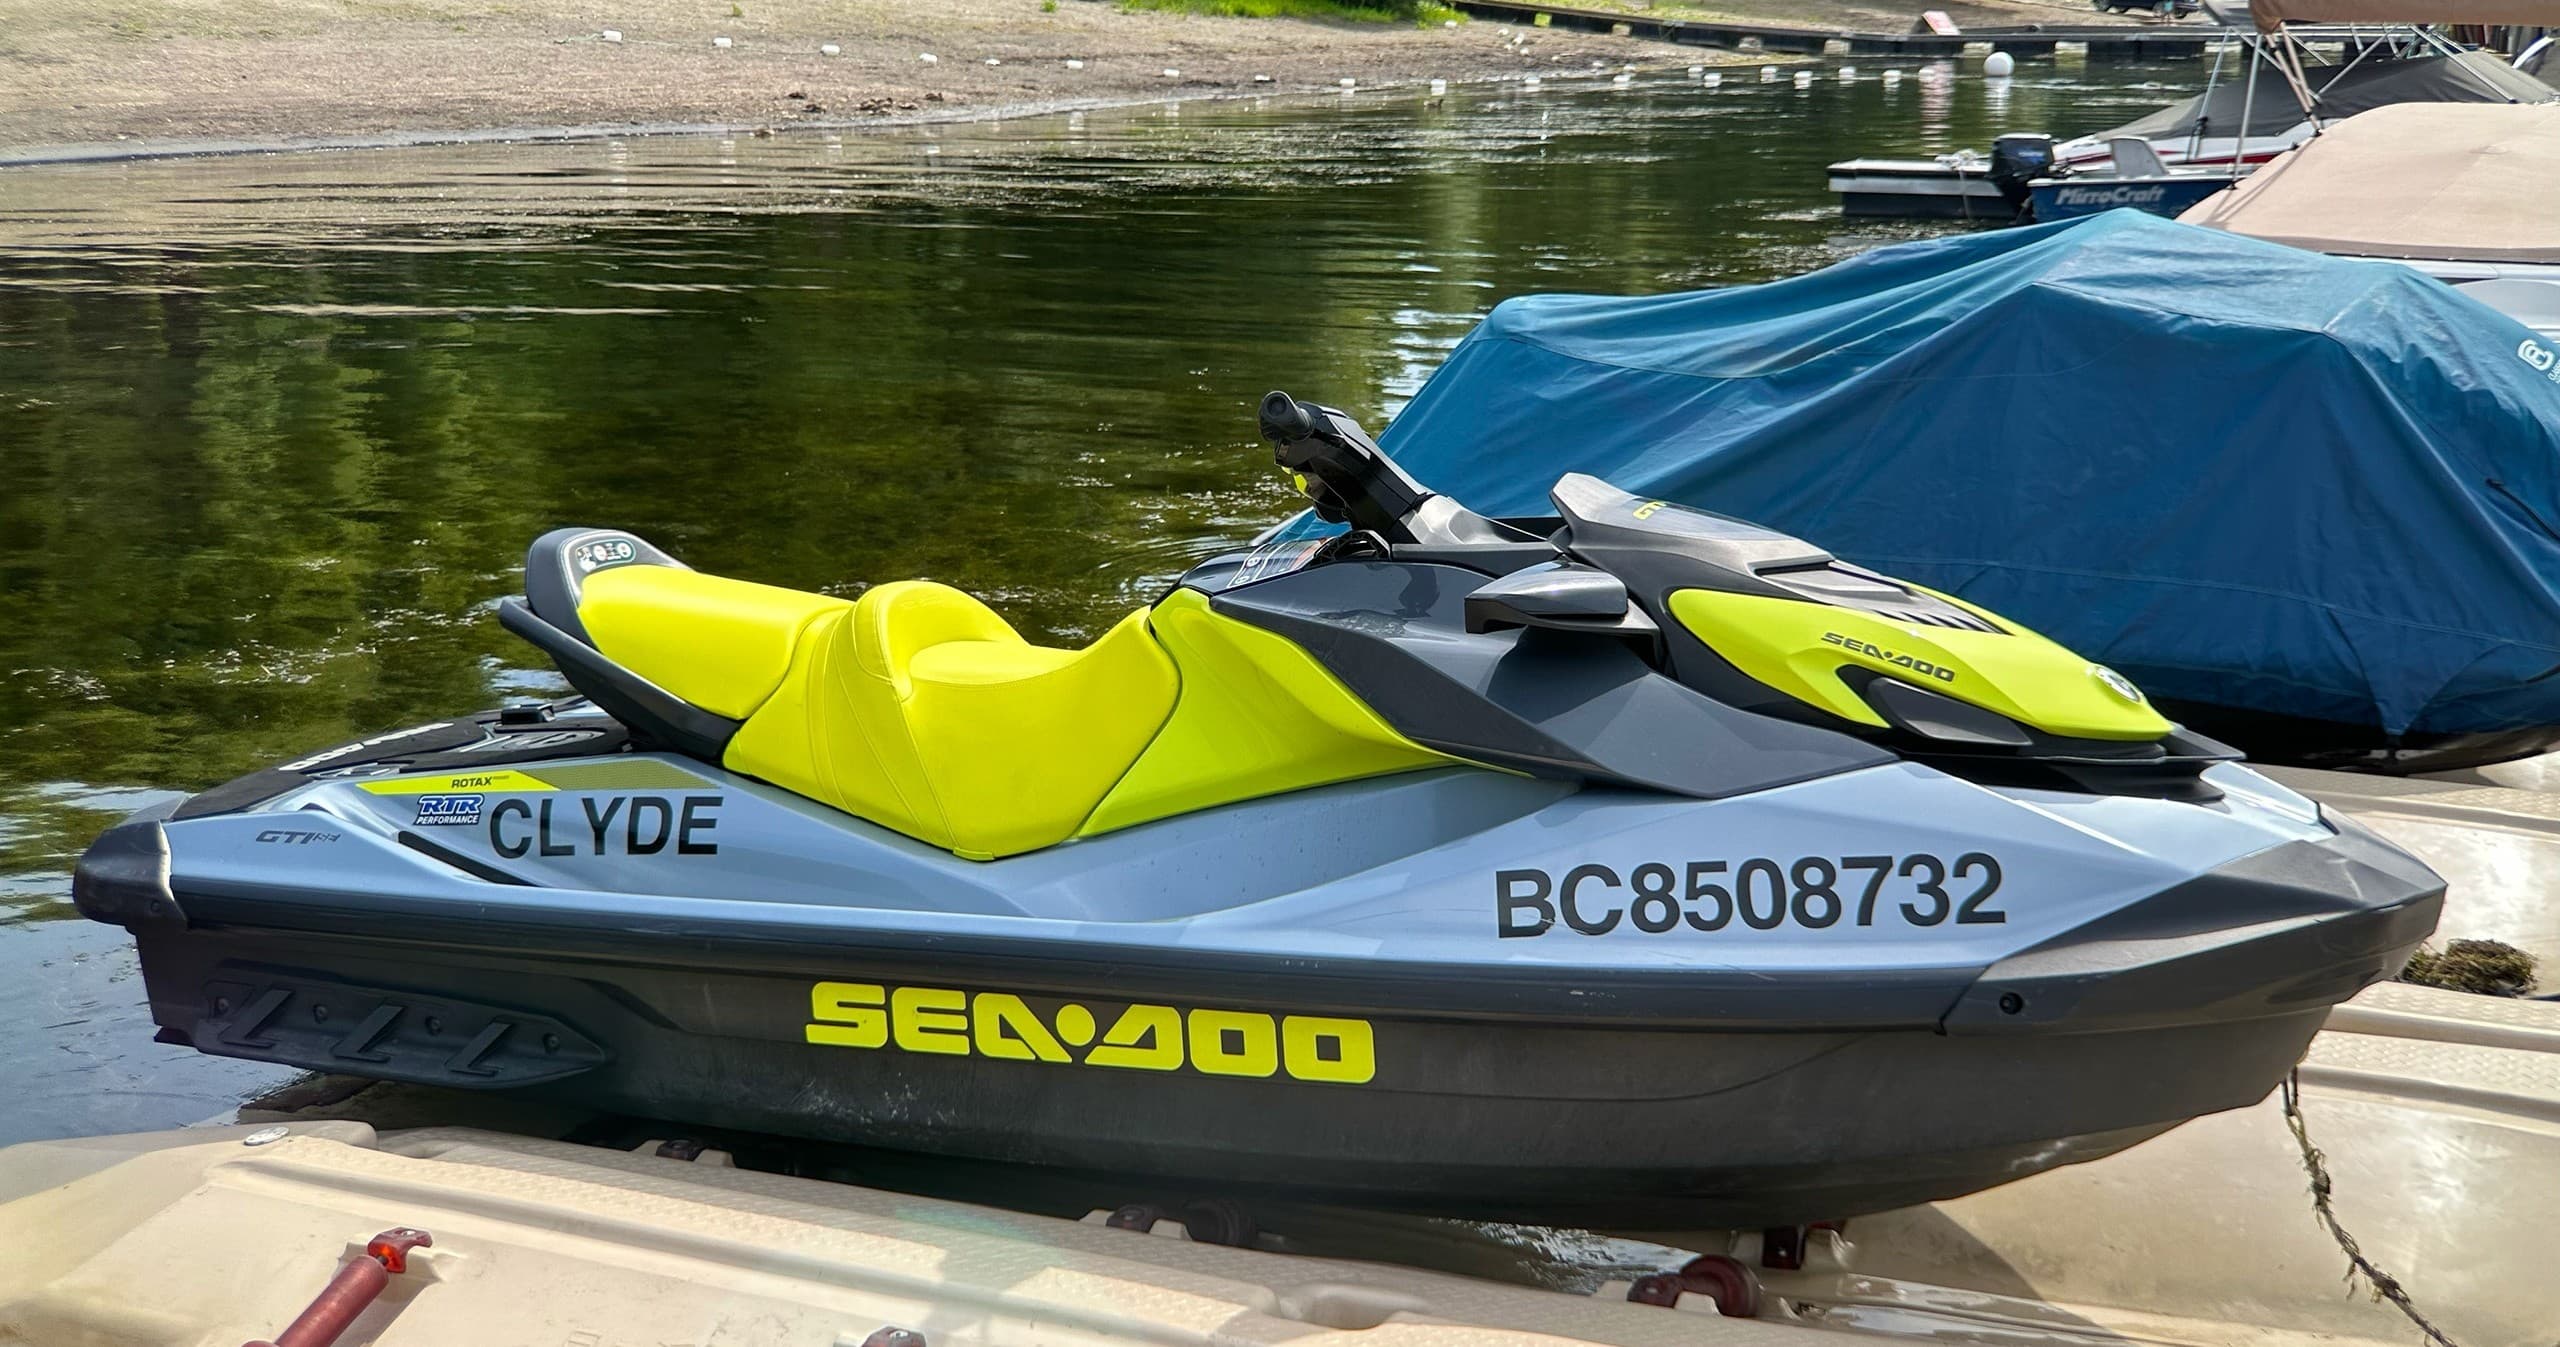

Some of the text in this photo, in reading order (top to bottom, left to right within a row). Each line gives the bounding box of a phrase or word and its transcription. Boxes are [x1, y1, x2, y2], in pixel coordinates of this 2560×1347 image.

[2055, 185, 2166, 206] MirroCraft
[451, 775, 493, 788] ROTAX
[419, 794, 484, 815] RTR
[416, 815, 479, 825] PERFORMANCE
[490, 796, 724, 859] CLYDE
[1496, 852, 2007, 938] BC8508732
